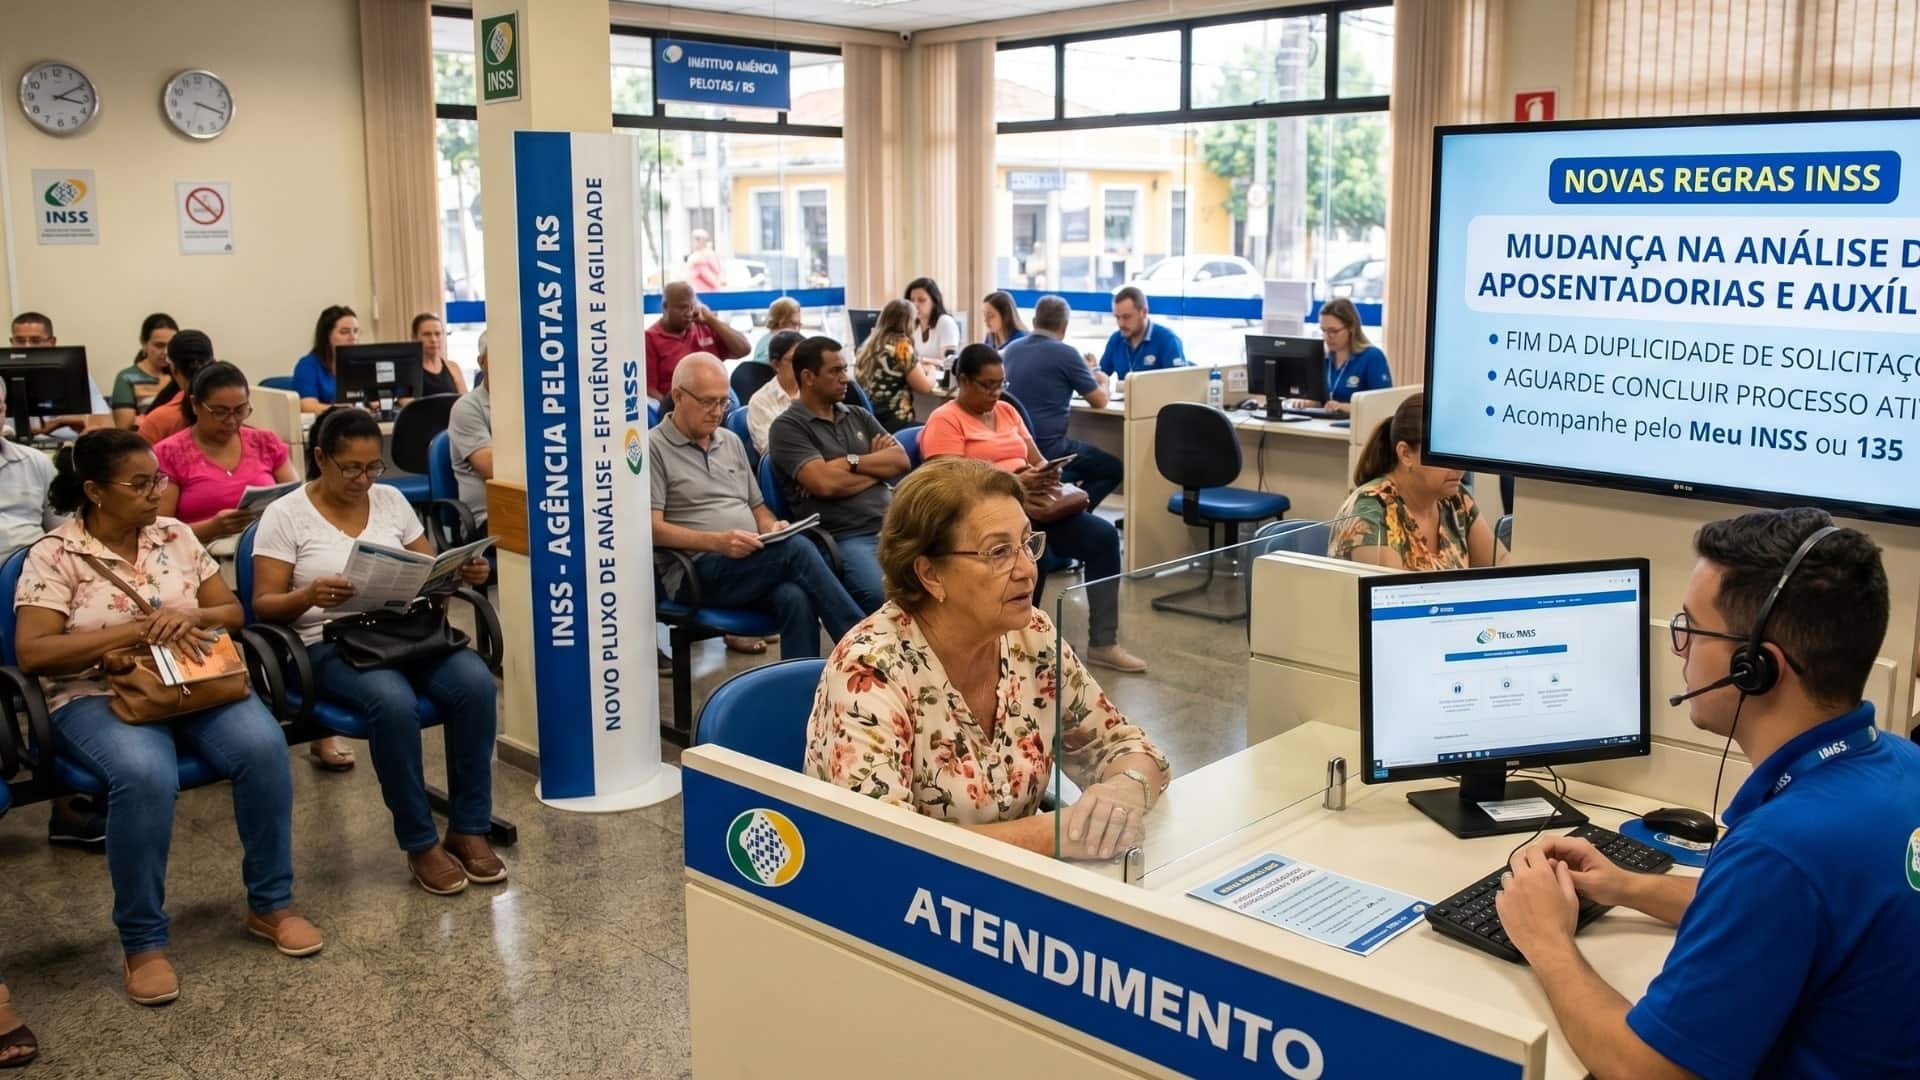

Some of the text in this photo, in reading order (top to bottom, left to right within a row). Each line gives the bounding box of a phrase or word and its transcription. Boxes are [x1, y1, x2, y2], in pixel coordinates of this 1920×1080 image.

[487, 69, 514, 92] INSS
[689, 77, 756, 94] PELOTAS / RS
[1564, 163, 1881, 194] NOVAS REGRAS INSS
[46, 210, 89, 224] INSS
[585, 177, 606, 295] AGILIDADE
[1506, 233, 1667, 269] MUDANÇA
[1677, 236, 1726, 264] NA
[1735, 229, 1889, 268] ANÁLISE
[589, 302, 606, 313] E
[1478, 272, 1766, 309] APOSENTADORIAS
[1777, 281, 1795, 309] E
[587, 319, 611, 438] EFICIÊNCIA
[1506, 331, 1920, 383] FIM DA DUPLICIDADE DE SOLICITAÇ
[1504, 367, 1606, 395] AGUARDE
[1612, 375, 1728, 405] CONCLUIR
[1737, 384, 1868, 416] PROCESSO
[535, 215, 575, 647] INSS - AGÊNCIA PELOTAS / RS
[1502, 404, 1904, 461] Acompanhe pelo Meu INSS ou 135
[592, 459, 615, 551] ANÁLISE
[599, 557, 616, 584] DE
[600, 591, 619, 661] PLUXO
[603, 668, 621, 731] NOVO
[903, 887, 1325, 1080] ATENDIMENTO
